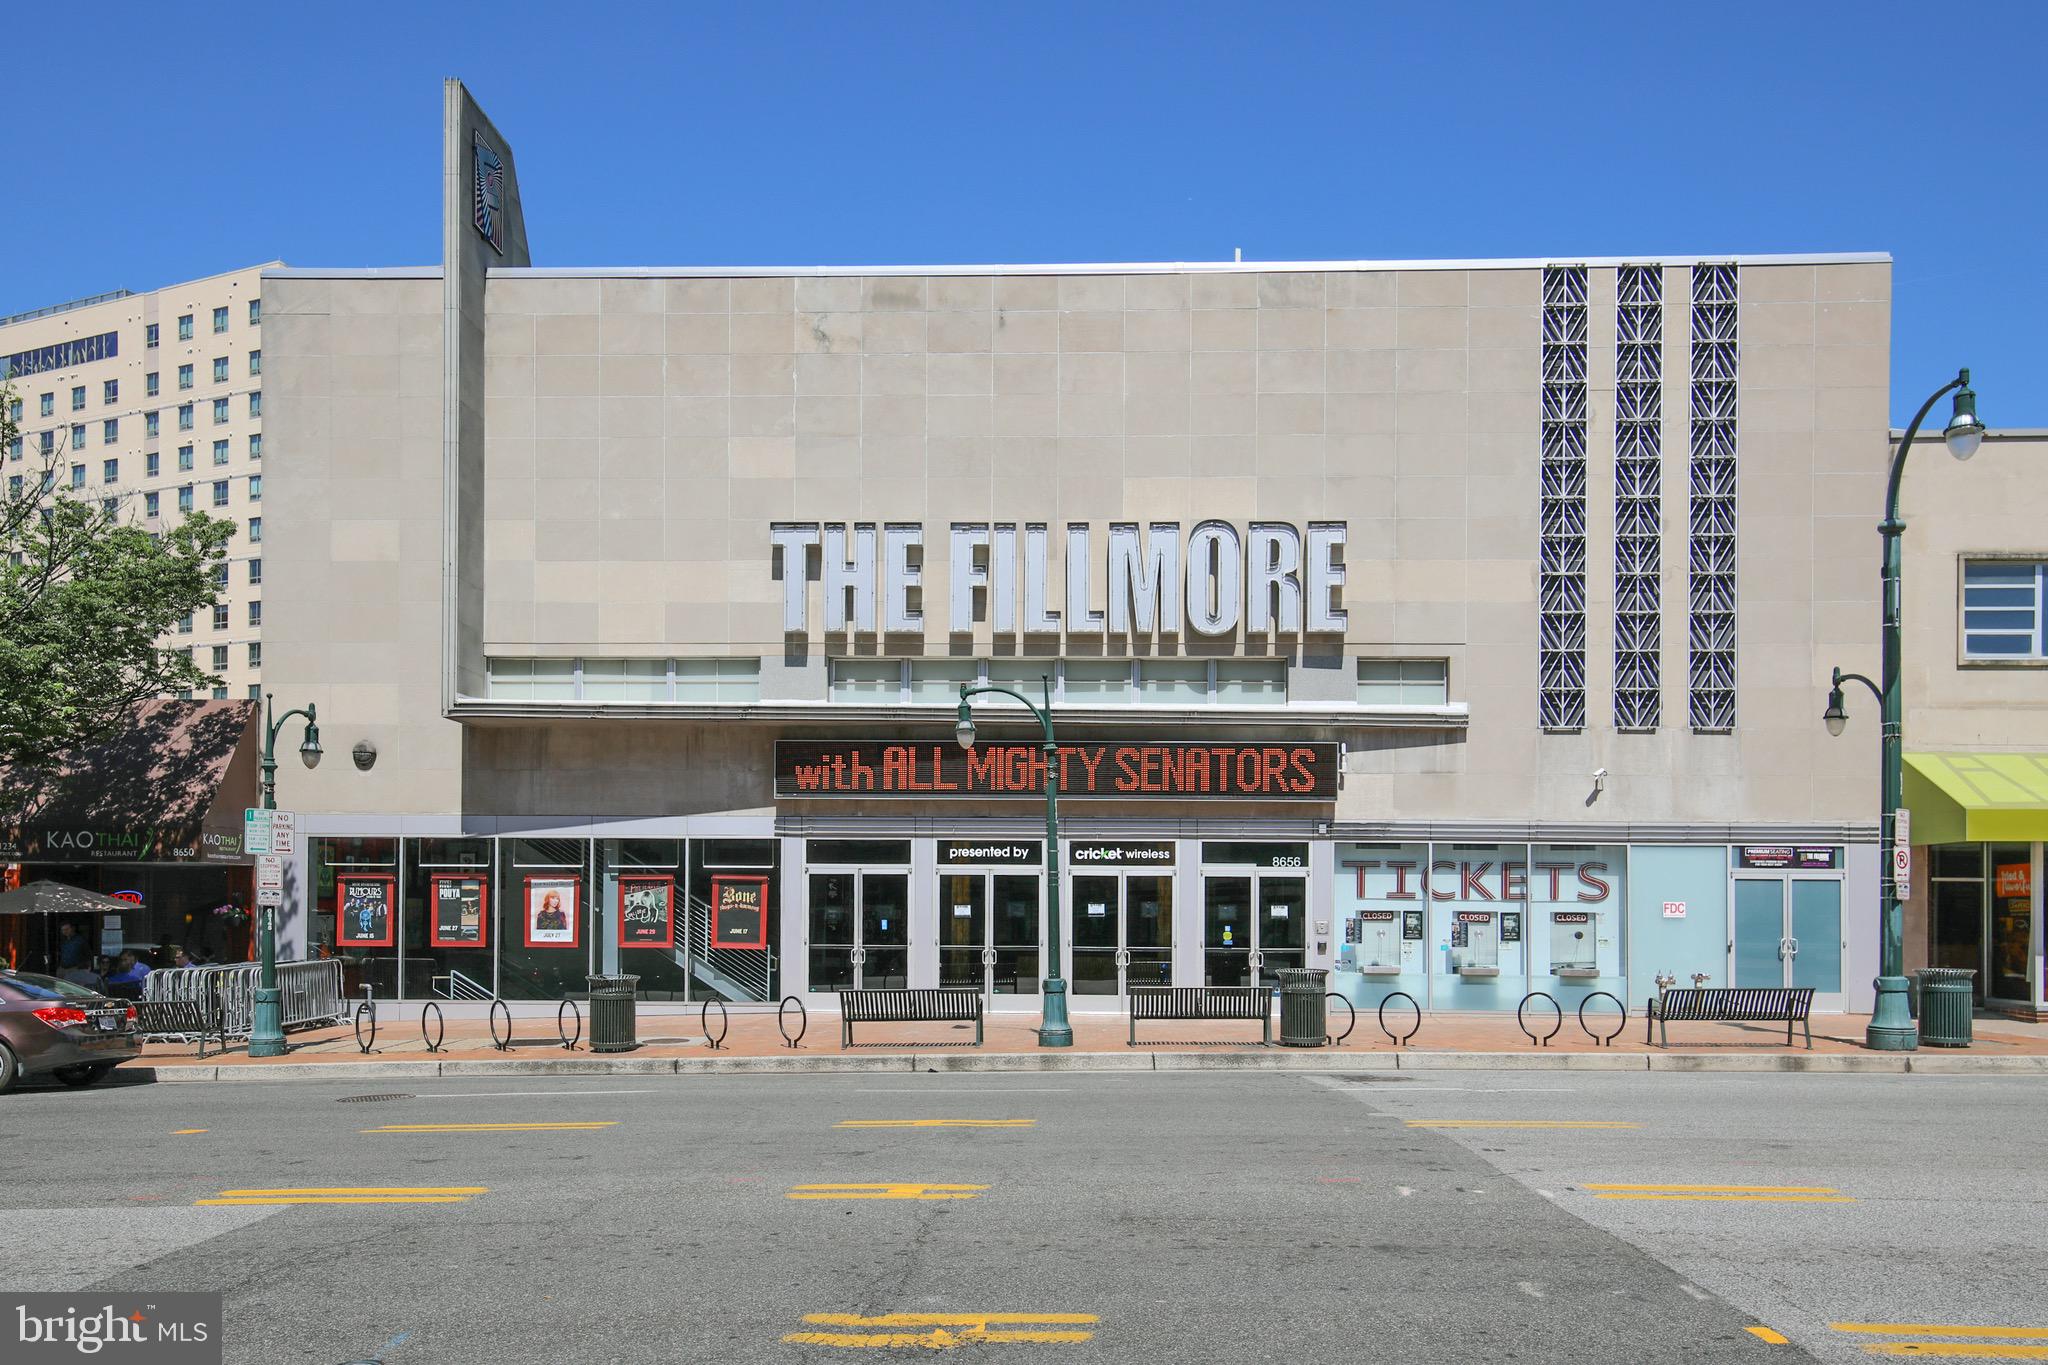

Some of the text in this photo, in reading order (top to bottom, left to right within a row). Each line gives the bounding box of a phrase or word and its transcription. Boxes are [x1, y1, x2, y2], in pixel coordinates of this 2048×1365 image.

[771, 519, 1348, 636] THE FILLMORE
[795, 746, 1316, 792] with ALL MIGHTY SENATORS
[272, 823, 294, 831] PARKING
[276, 831, 289, 839] ANY
[173, 847, 195, 857] 8650
[949, 846, 1029, 860] presented by
[1075, 848, 1170, 860] cricket wireless
[1272, 856, 1301, 867] 8656
[1341, 860, 1610, 902] TICKETS
[349, 886, 383, 898] RUMOURS
[439, 888, 461, 898] POUYA
[722, 886, 757, 904] Bone
[1664, 902, 1685, 914] FDC
[1362, 912, 1393, 920] CLOSED
[1459, 913, 1490, 922] CLOSED
[1556, 914, 1587, 922] CLOSED
